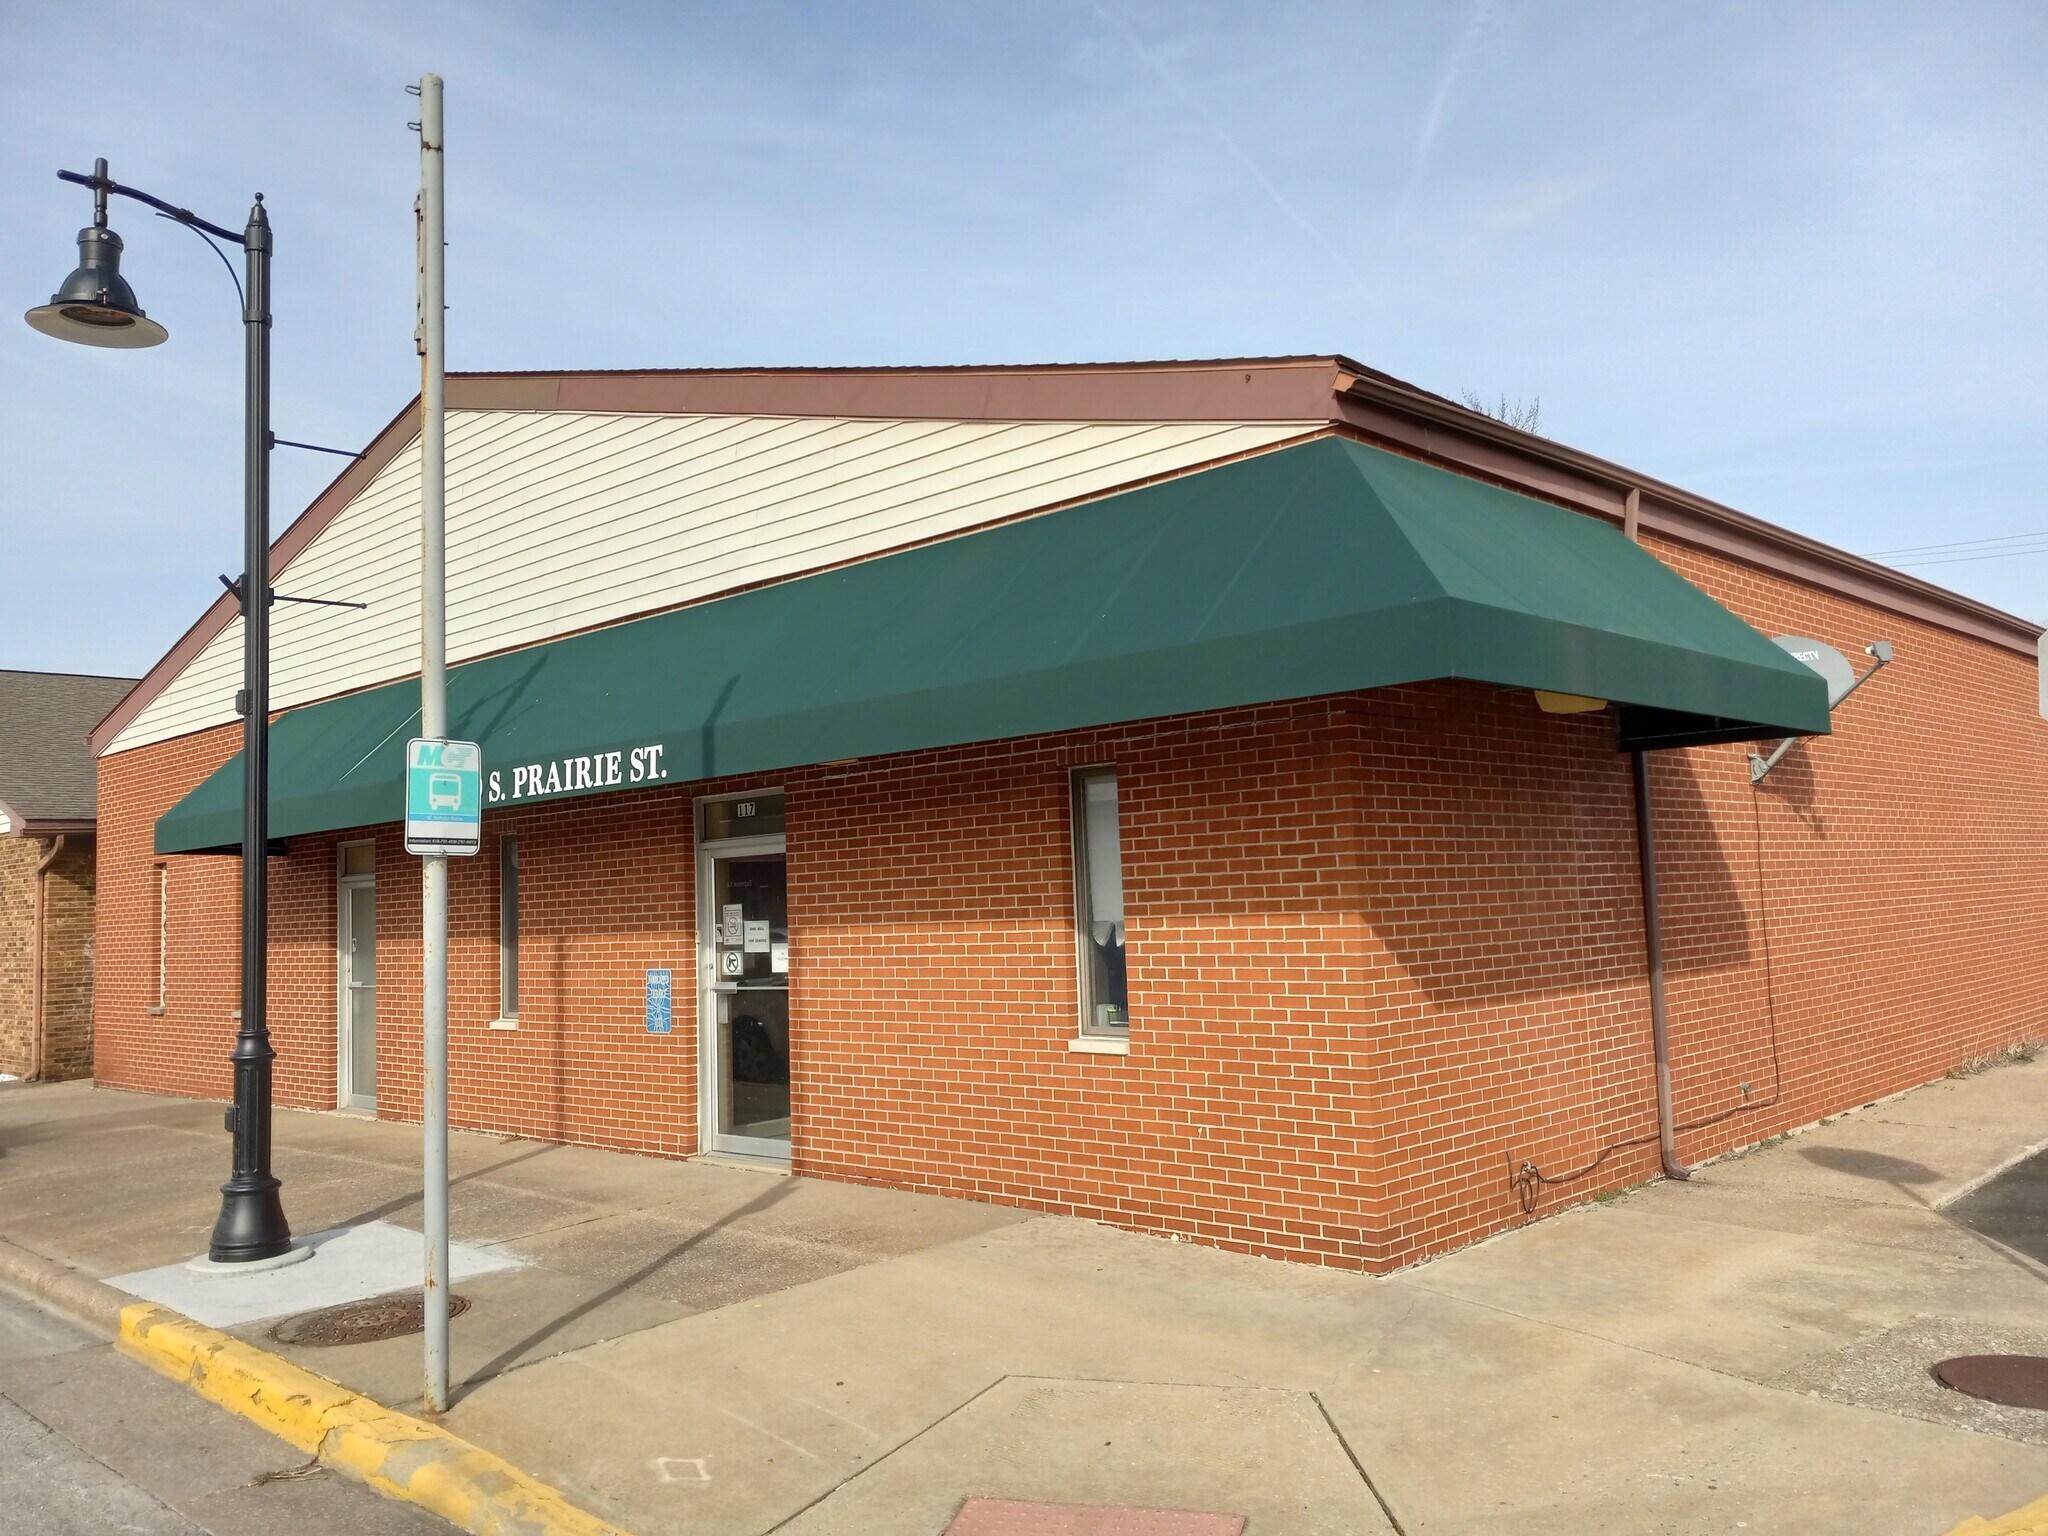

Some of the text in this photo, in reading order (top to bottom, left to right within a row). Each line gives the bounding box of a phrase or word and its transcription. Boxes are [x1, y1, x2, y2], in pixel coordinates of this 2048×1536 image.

[1790, 650, 1820, 662] RECTV
[417, 745, 473, 769] MCT
[488, 770, 506, 803] S.
[512, 751, 623, 799] PRAIRIE
[630, 744, 668, 783] ST.
[738, 803, 755, 817] 117
